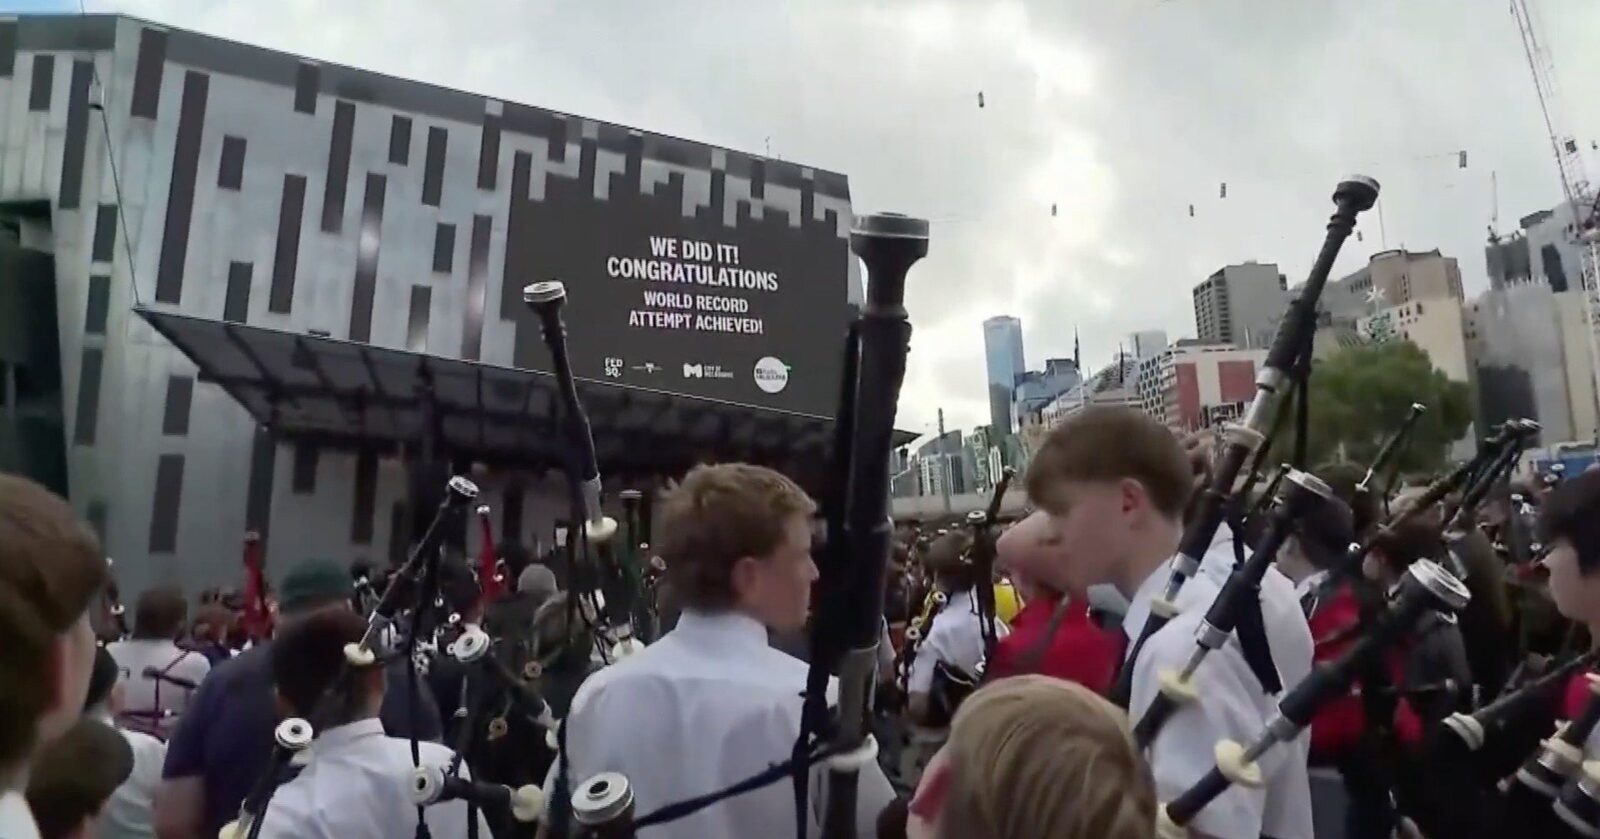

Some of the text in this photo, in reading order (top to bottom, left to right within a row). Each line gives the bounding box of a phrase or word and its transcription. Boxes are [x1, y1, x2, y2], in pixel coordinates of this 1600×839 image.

[650, 236, 739, 264] WE DID IT!
[607, 257, 778, 291] CONGRATULATIONS
[644, 290, 748, 313] WORLD RECORD
[629, 310, 763, 334] ATTEMPT ACHIEVED!
[604, 357, 623, 367] FED
[604, 367, 622, 378] SQ.
